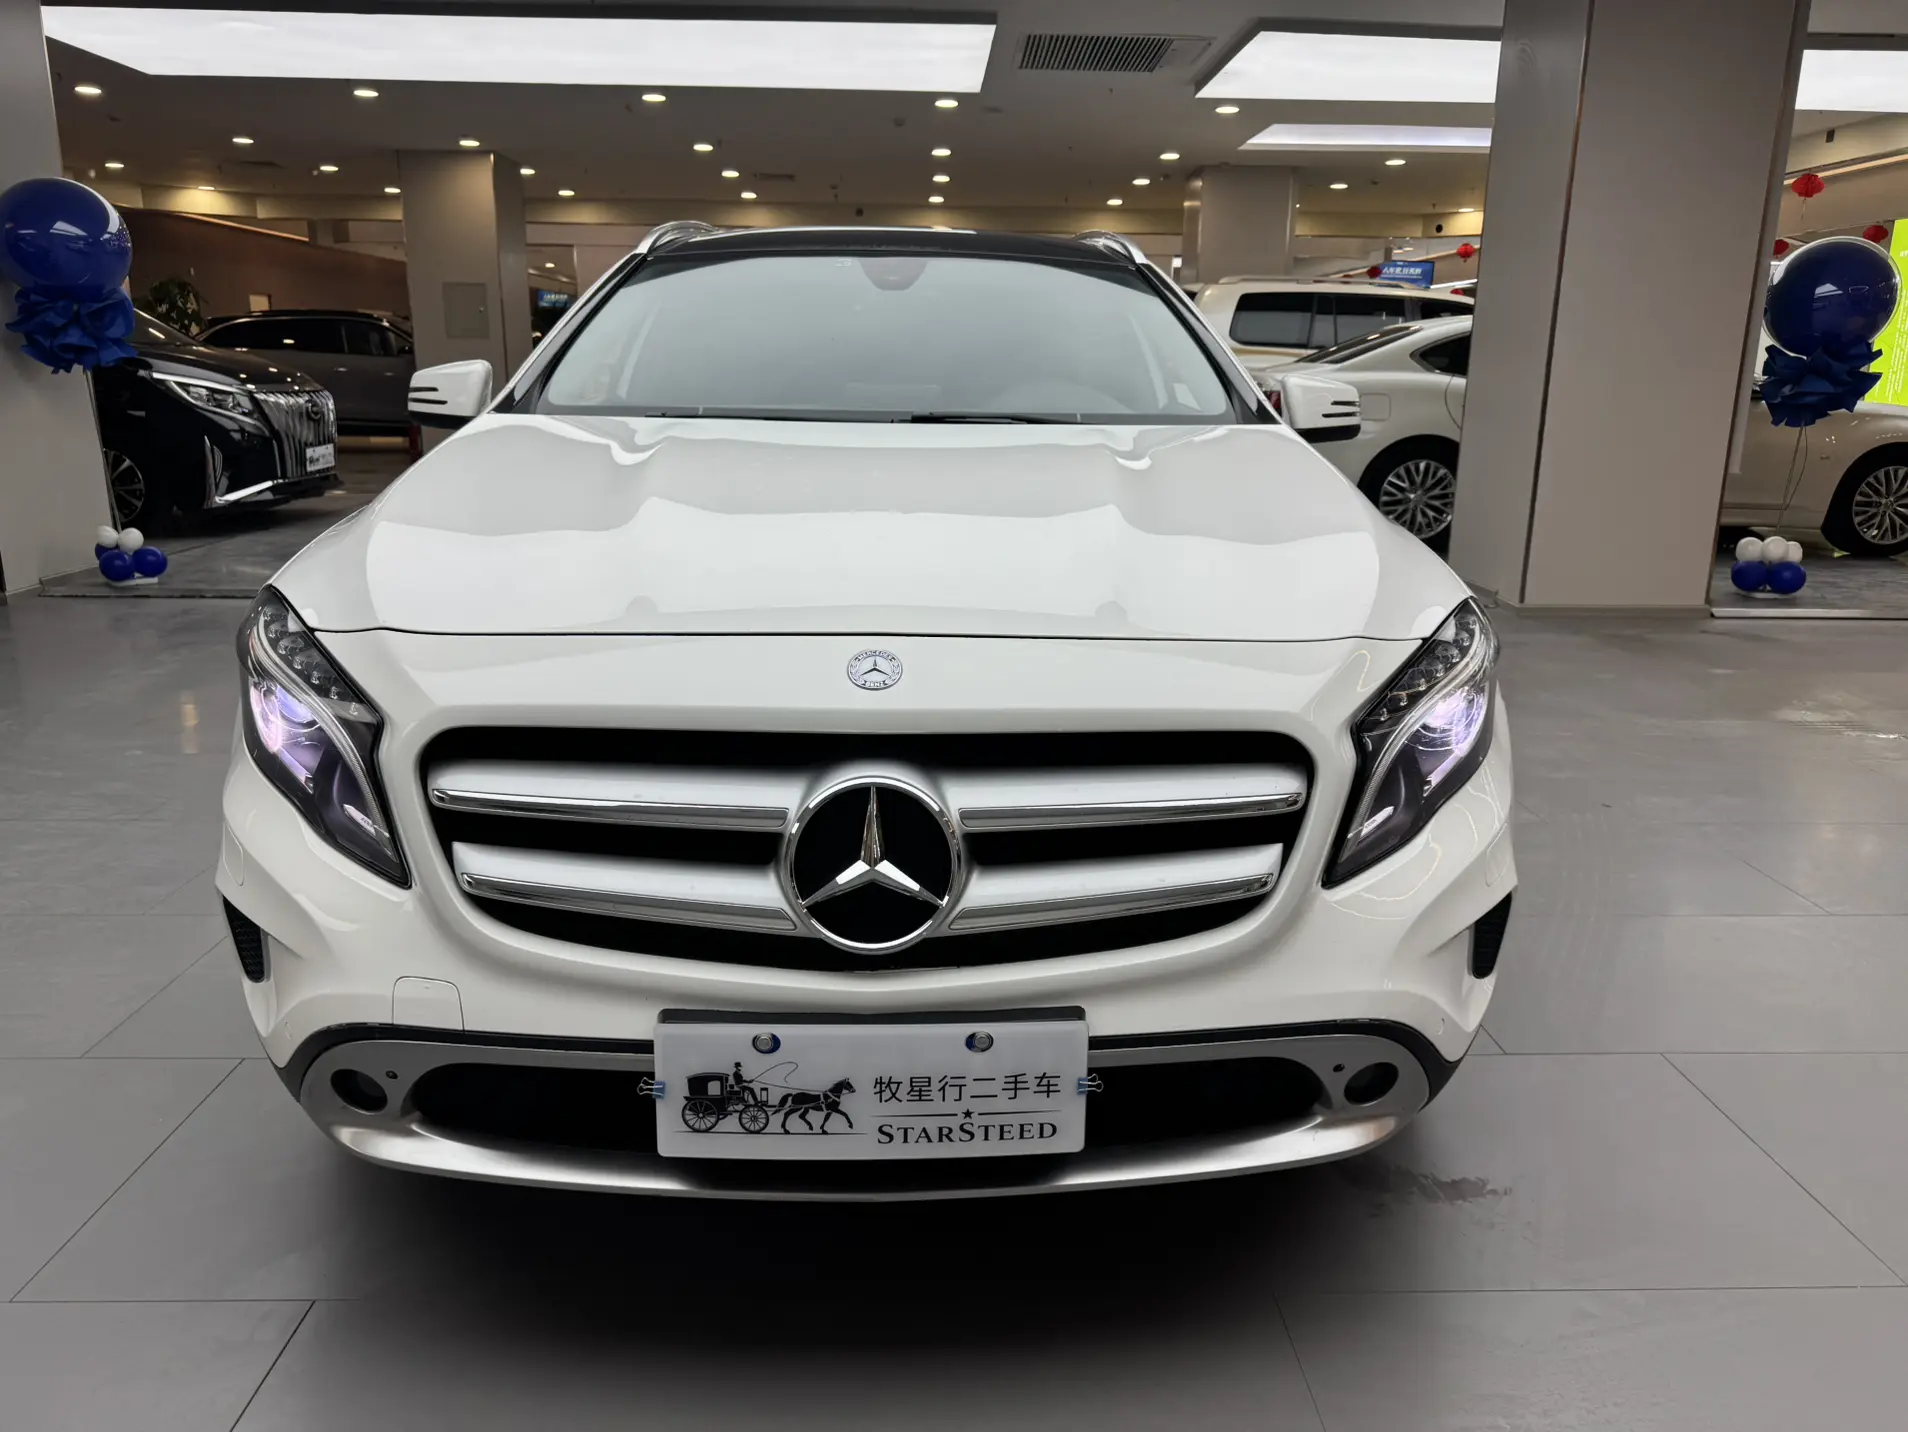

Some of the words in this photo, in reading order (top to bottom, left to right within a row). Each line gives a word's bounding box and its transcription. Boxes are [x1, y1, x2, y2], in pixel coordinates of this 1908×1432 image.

[873, 1071, 1062, 1104] 牧星行二手车
